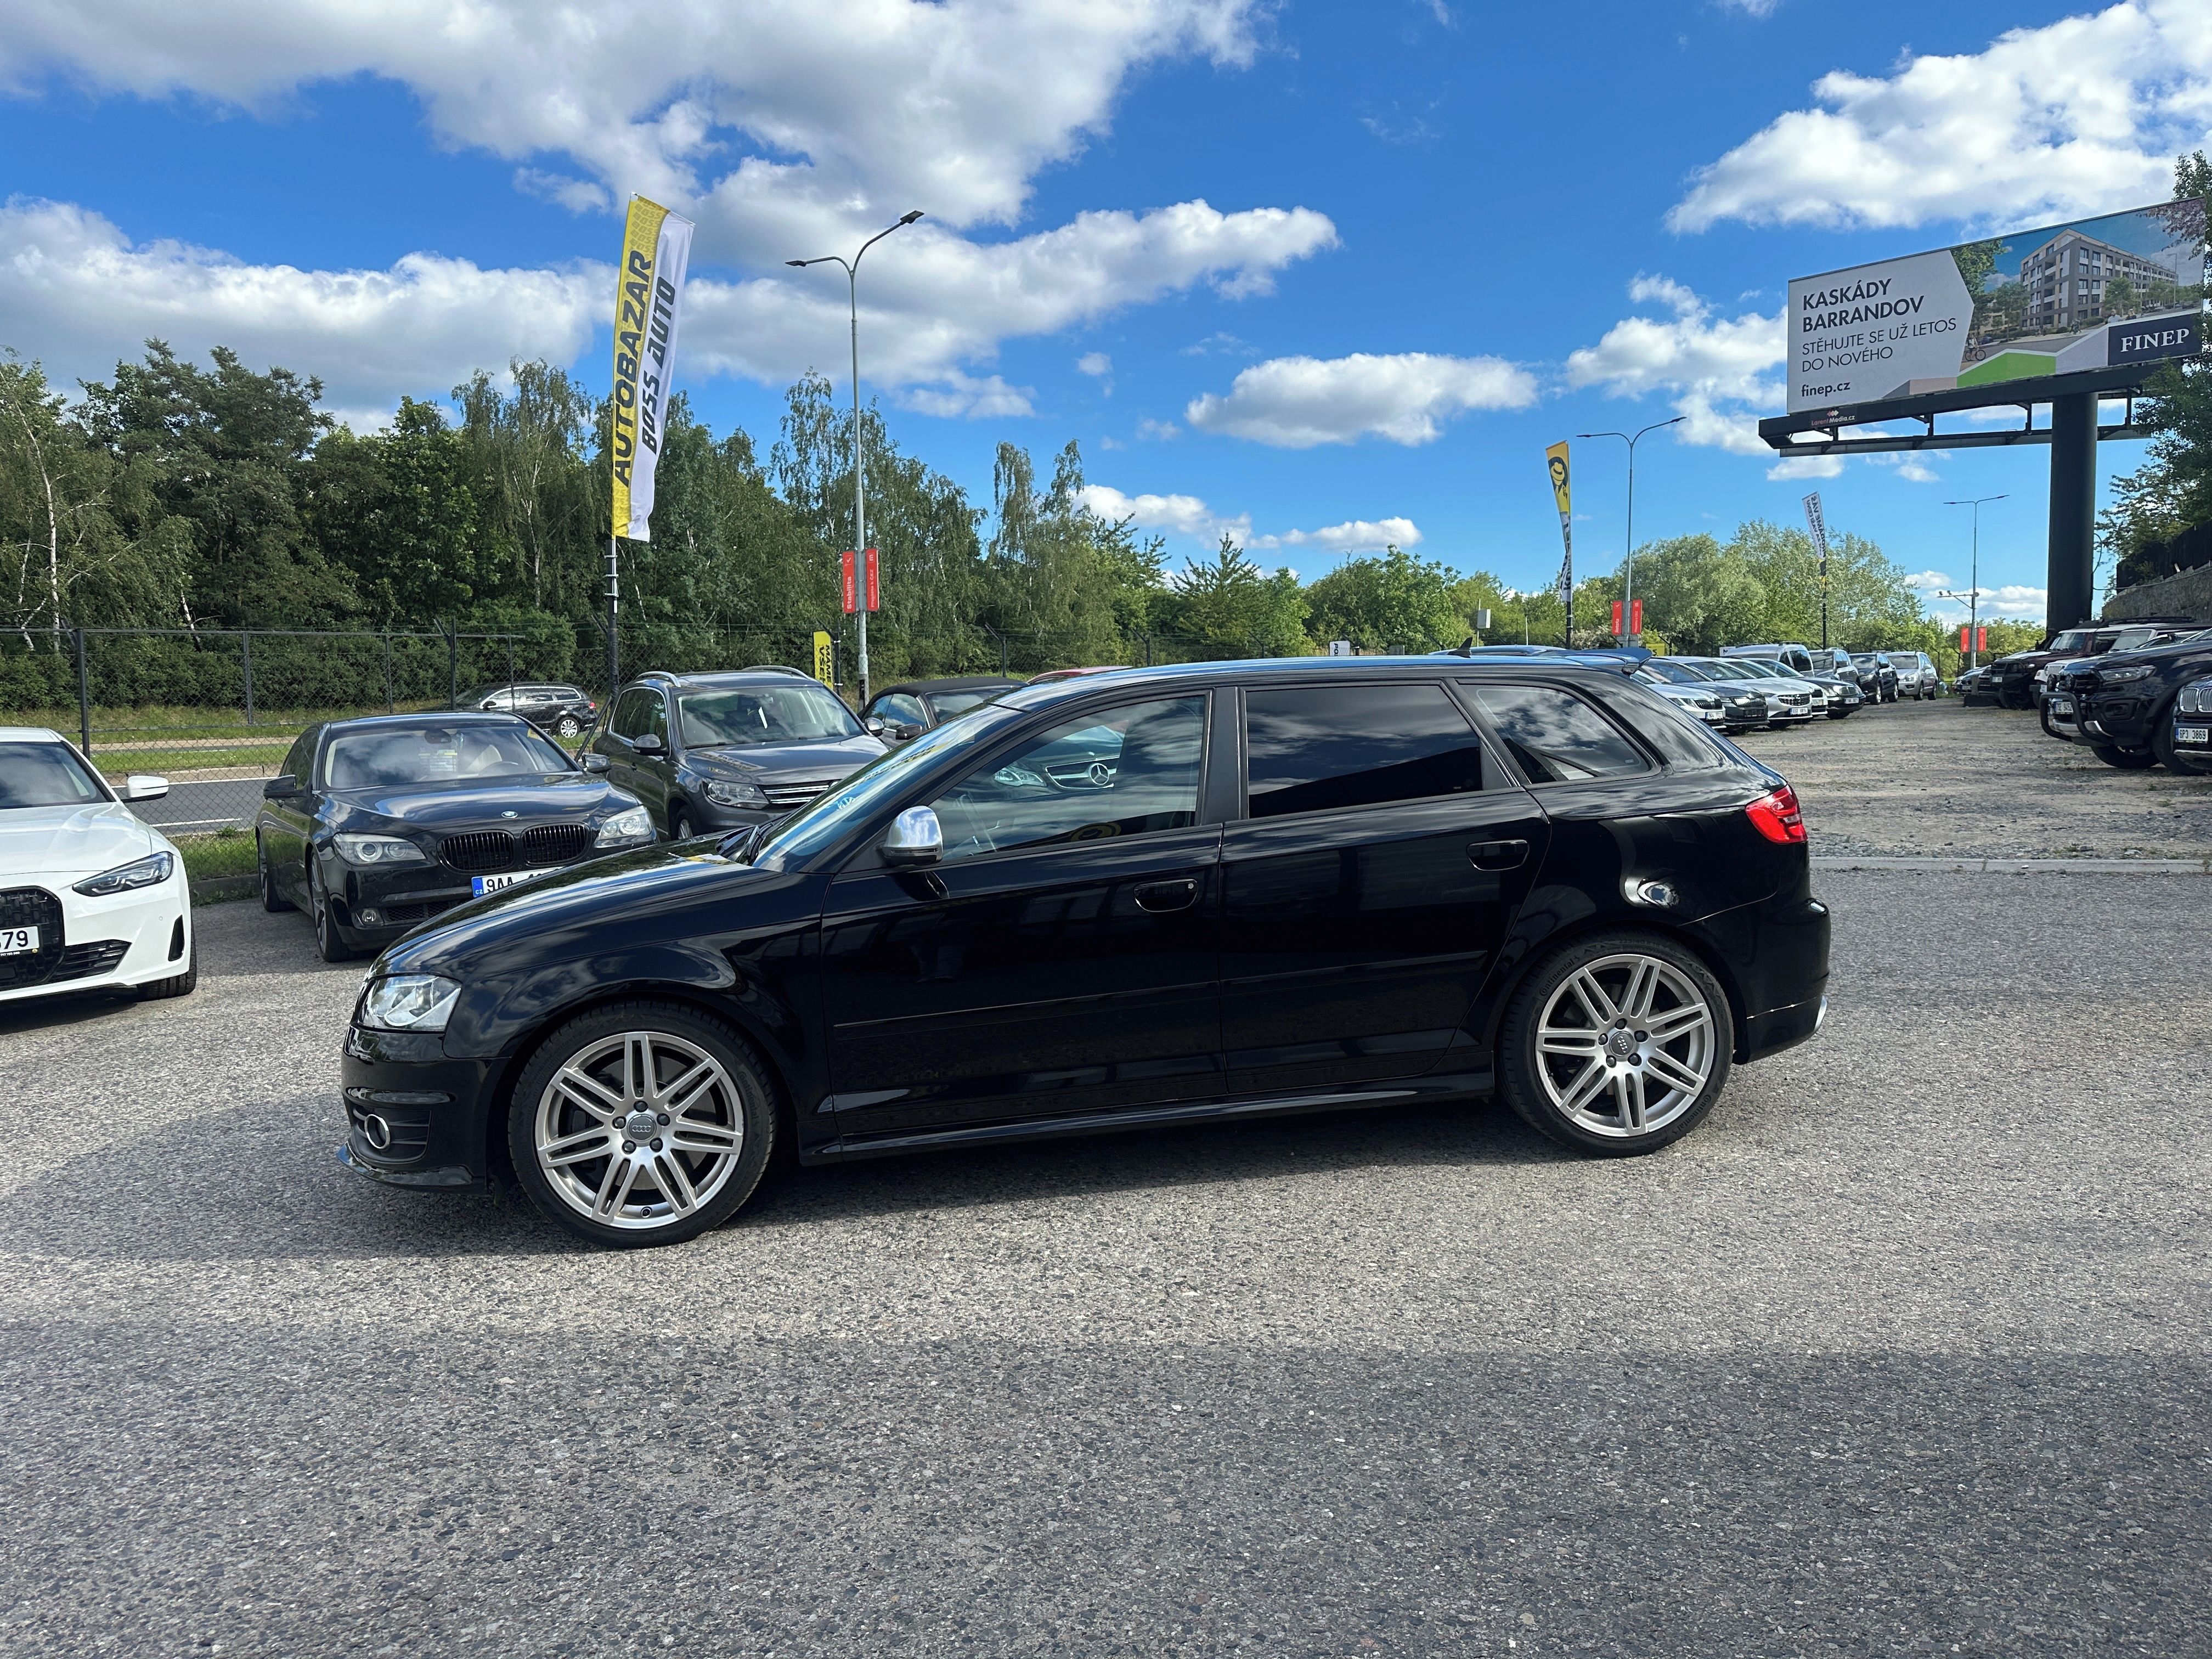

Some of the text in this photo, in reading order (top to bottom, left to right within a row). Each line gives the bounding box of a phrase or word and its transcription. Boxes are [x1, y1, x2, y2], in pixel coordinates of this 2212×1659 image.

[1803, 278, 1891, 310] KASKÁDY
[1803, 295, 1924, 333] BARRANDOV
[1802, 318, 1956, 355] STĚHUJTE SE UŽ LETOS
[2120, 329, 2190, 352] FINEP
[614, 250, 651, 488] AUTOBAZAR
[642, 276, 675, 455] BOSS AUTO
[1802, 346, 1893, 372] DO NOVÉHO
[1802, 382, 1850, 397] finep.cz
[2192, 730, 2206, 740] 3869
[0, 930, 28, 949] 79
[1538, 957, 1575, 997] Continental
[736, 1071, 759, 1120] Continental
